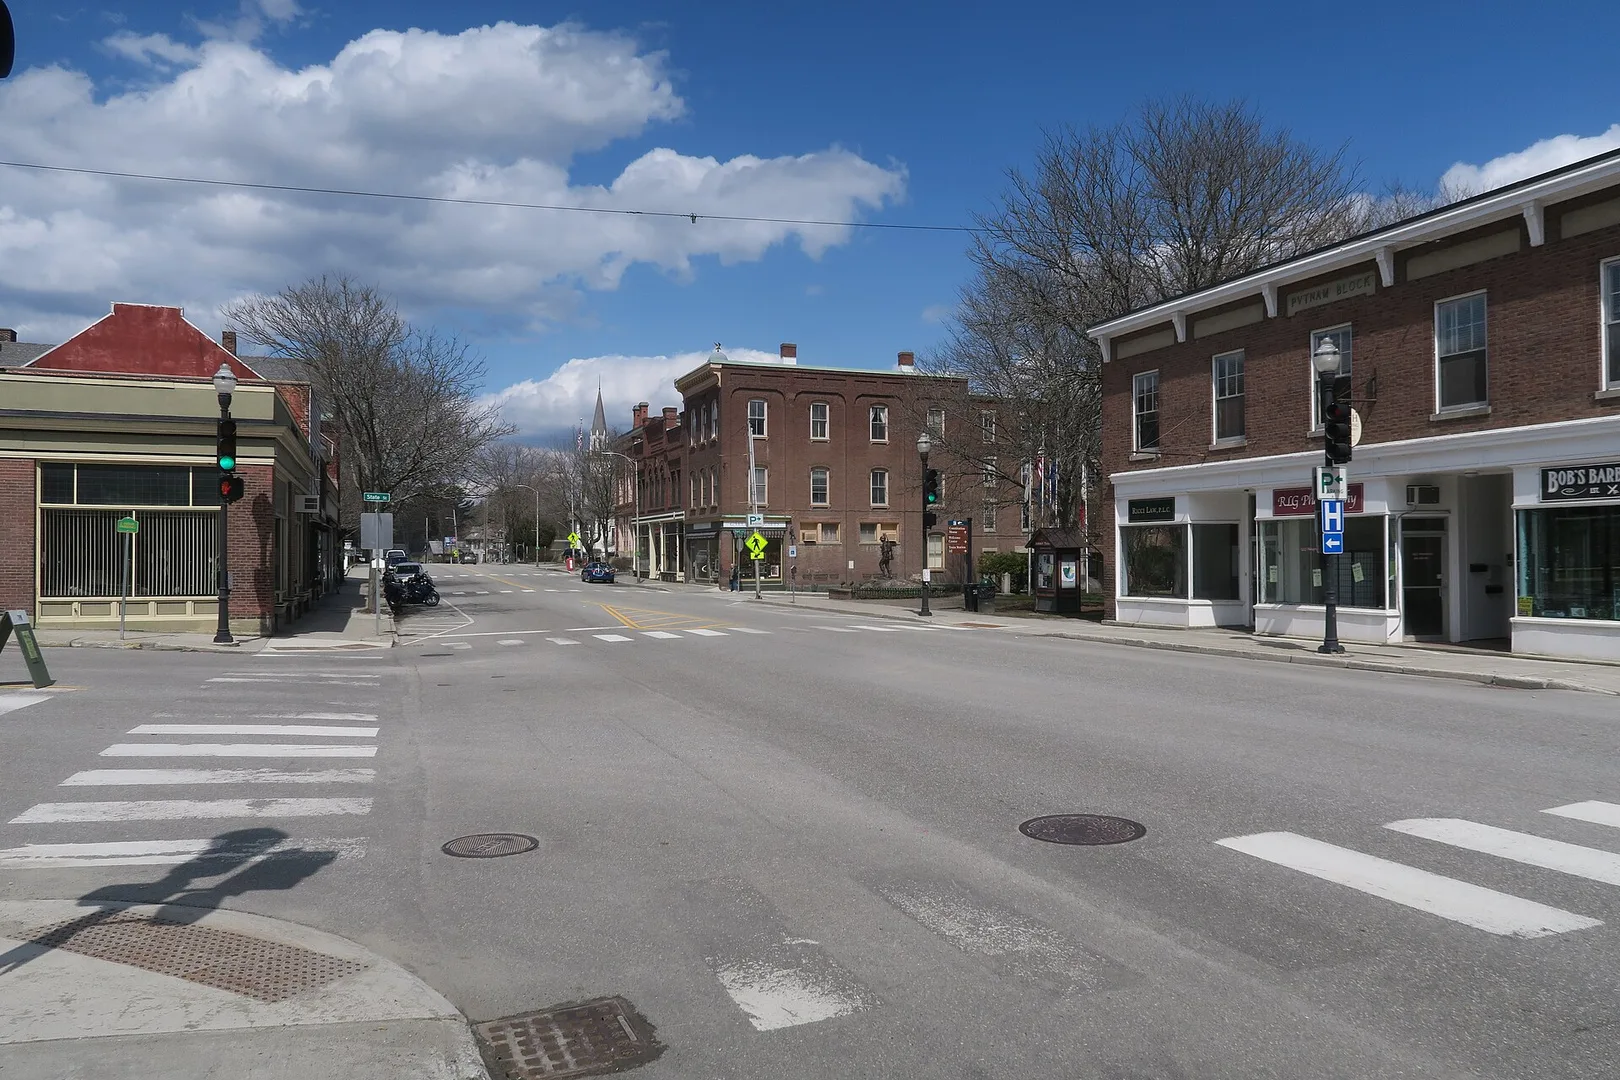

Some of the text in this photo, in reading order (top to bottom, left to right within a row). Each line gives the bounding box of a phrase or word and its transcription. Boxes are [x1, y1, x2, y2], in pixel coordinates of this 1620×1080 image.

[1336, 276, 1371, 296] BLOCK
[1547, 469, 1586, 494] BOB'S
[1324, 501, 1342, 531] H
